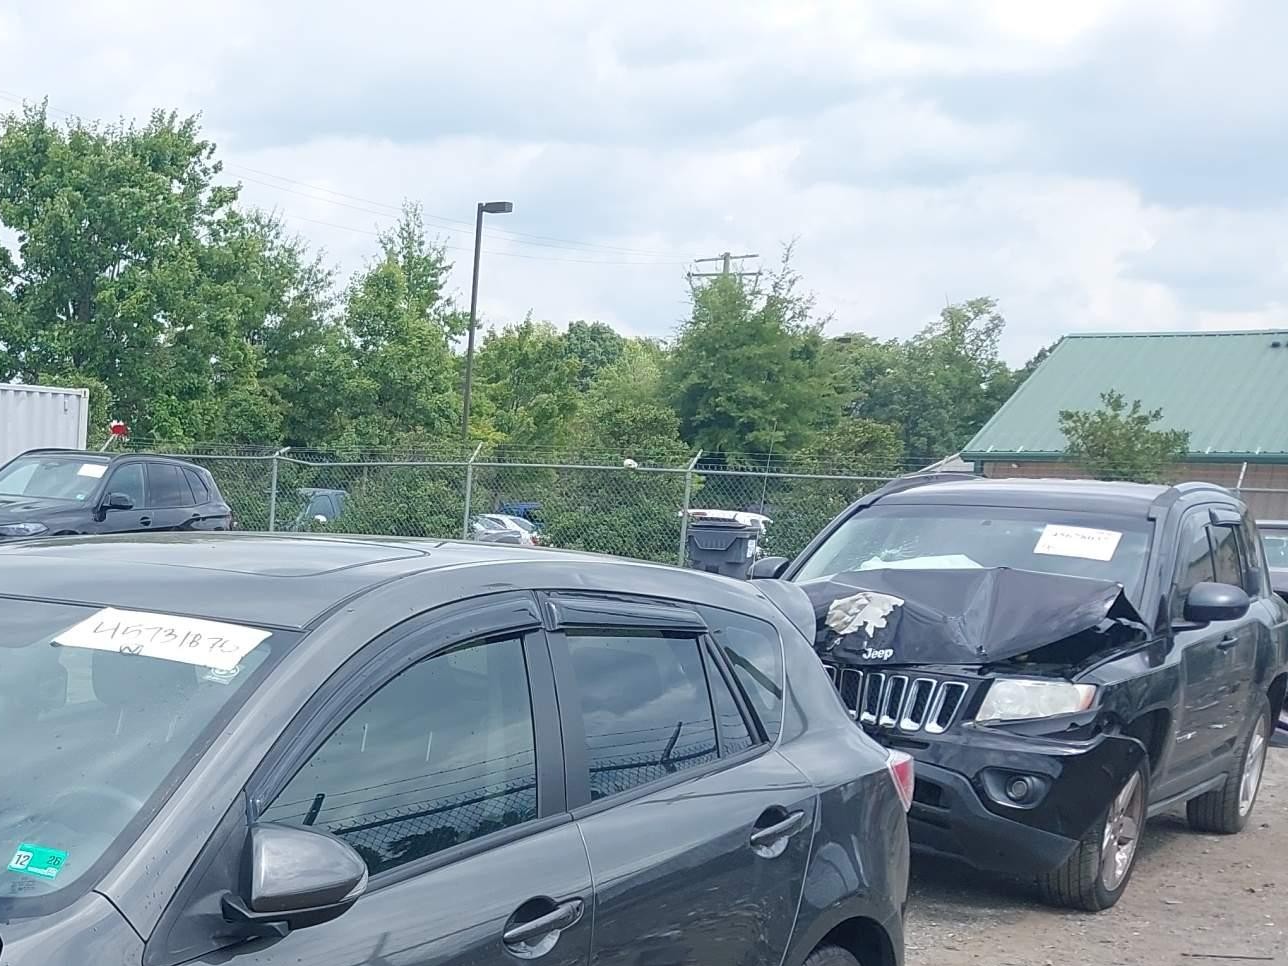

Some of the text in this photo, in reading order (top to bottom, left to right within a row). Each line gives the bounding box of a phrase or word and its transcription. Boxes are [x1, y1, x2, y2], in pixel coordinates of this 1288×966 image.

[862, 647, 894, 661] Jeep
[14, 853, 63, 866] 12 26
